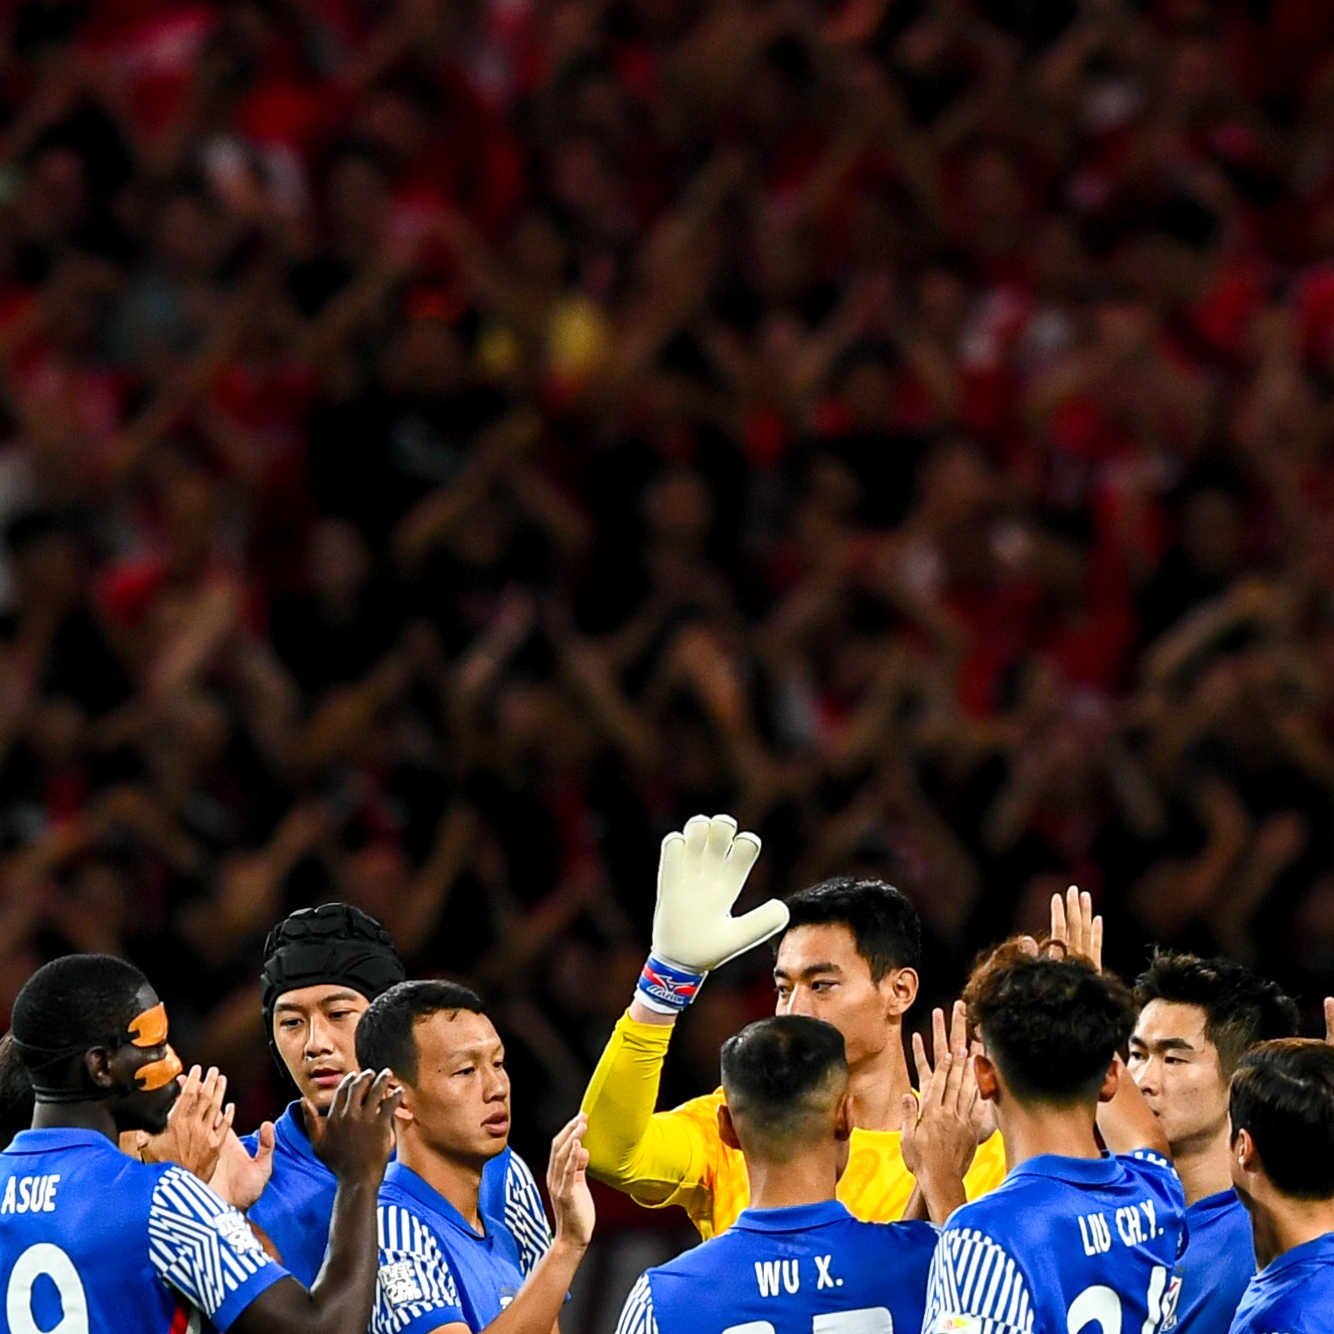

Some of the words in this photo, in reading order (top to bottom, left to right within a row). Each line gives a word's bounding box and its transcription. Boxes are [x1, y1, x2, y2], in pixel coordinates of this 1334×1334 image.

[0, 1174, 61, 1216] ASUE
[1077, 1211, 1111, 1257] LIU
[1116, 1199, 1165, 1248] CH.Y.
[754, 1258, 800, 1298] WU
[813, 1253, 844, 1291] X.
